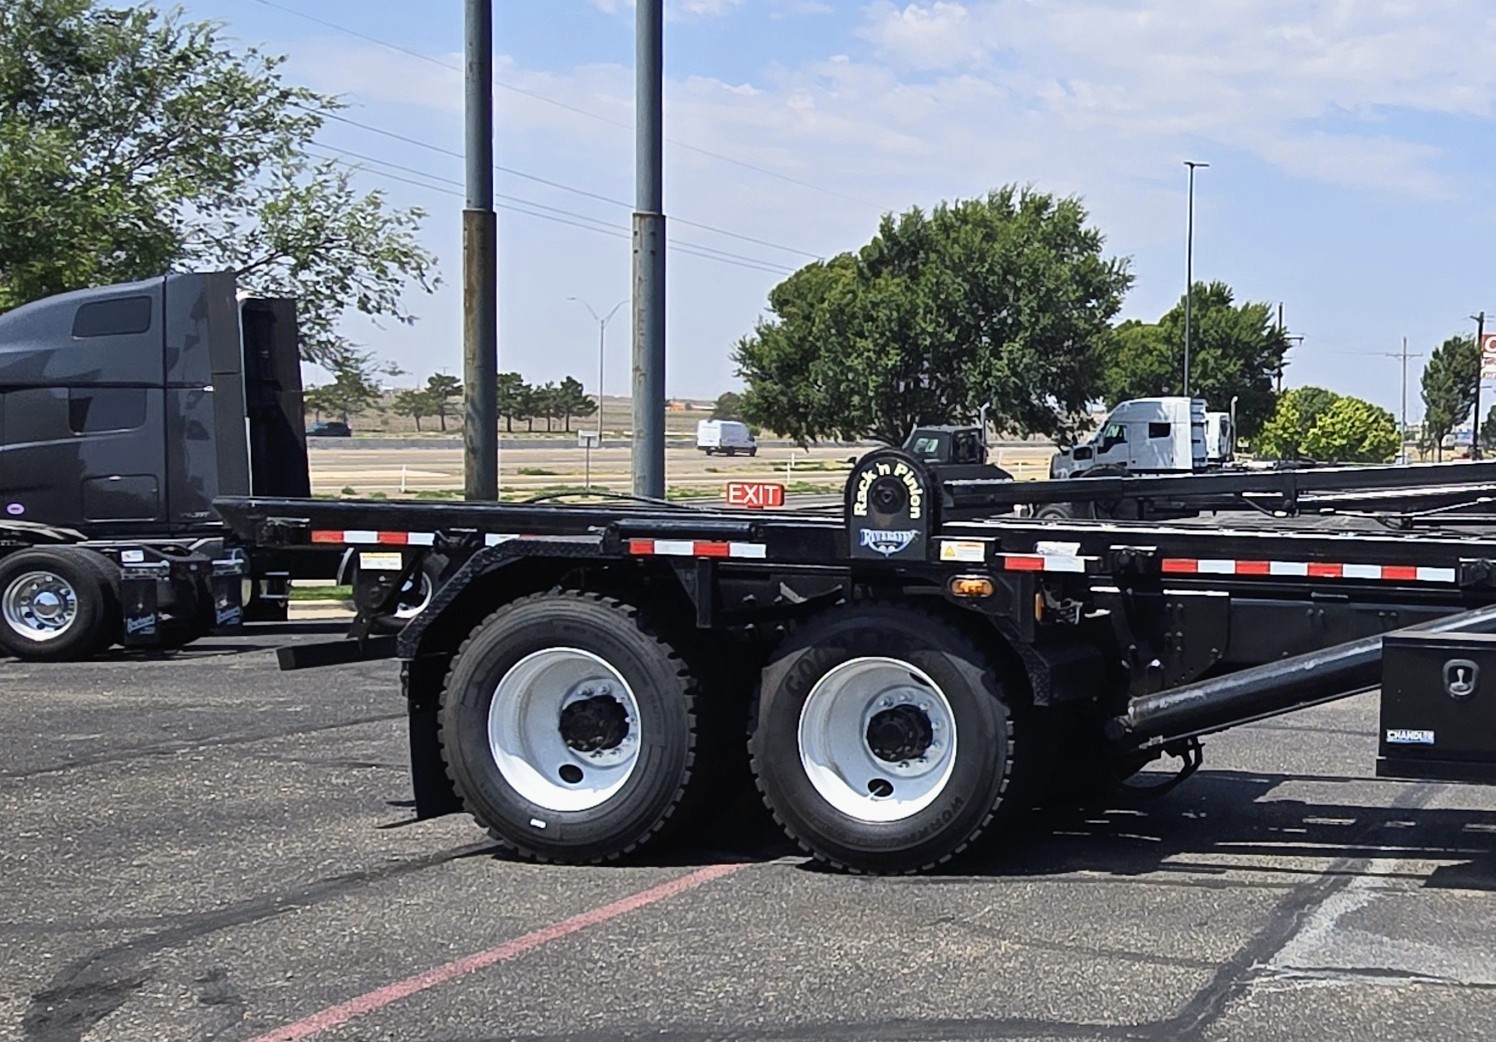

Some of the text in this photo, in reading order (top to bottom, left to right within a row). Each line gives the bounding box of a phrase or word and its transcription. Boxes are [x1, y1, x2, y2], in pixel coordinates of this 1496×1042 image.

[729, 484, 779, 505] EXIT
[854, 470, 878, 516] Rack
[893, 463, 923, 519] Pinion
